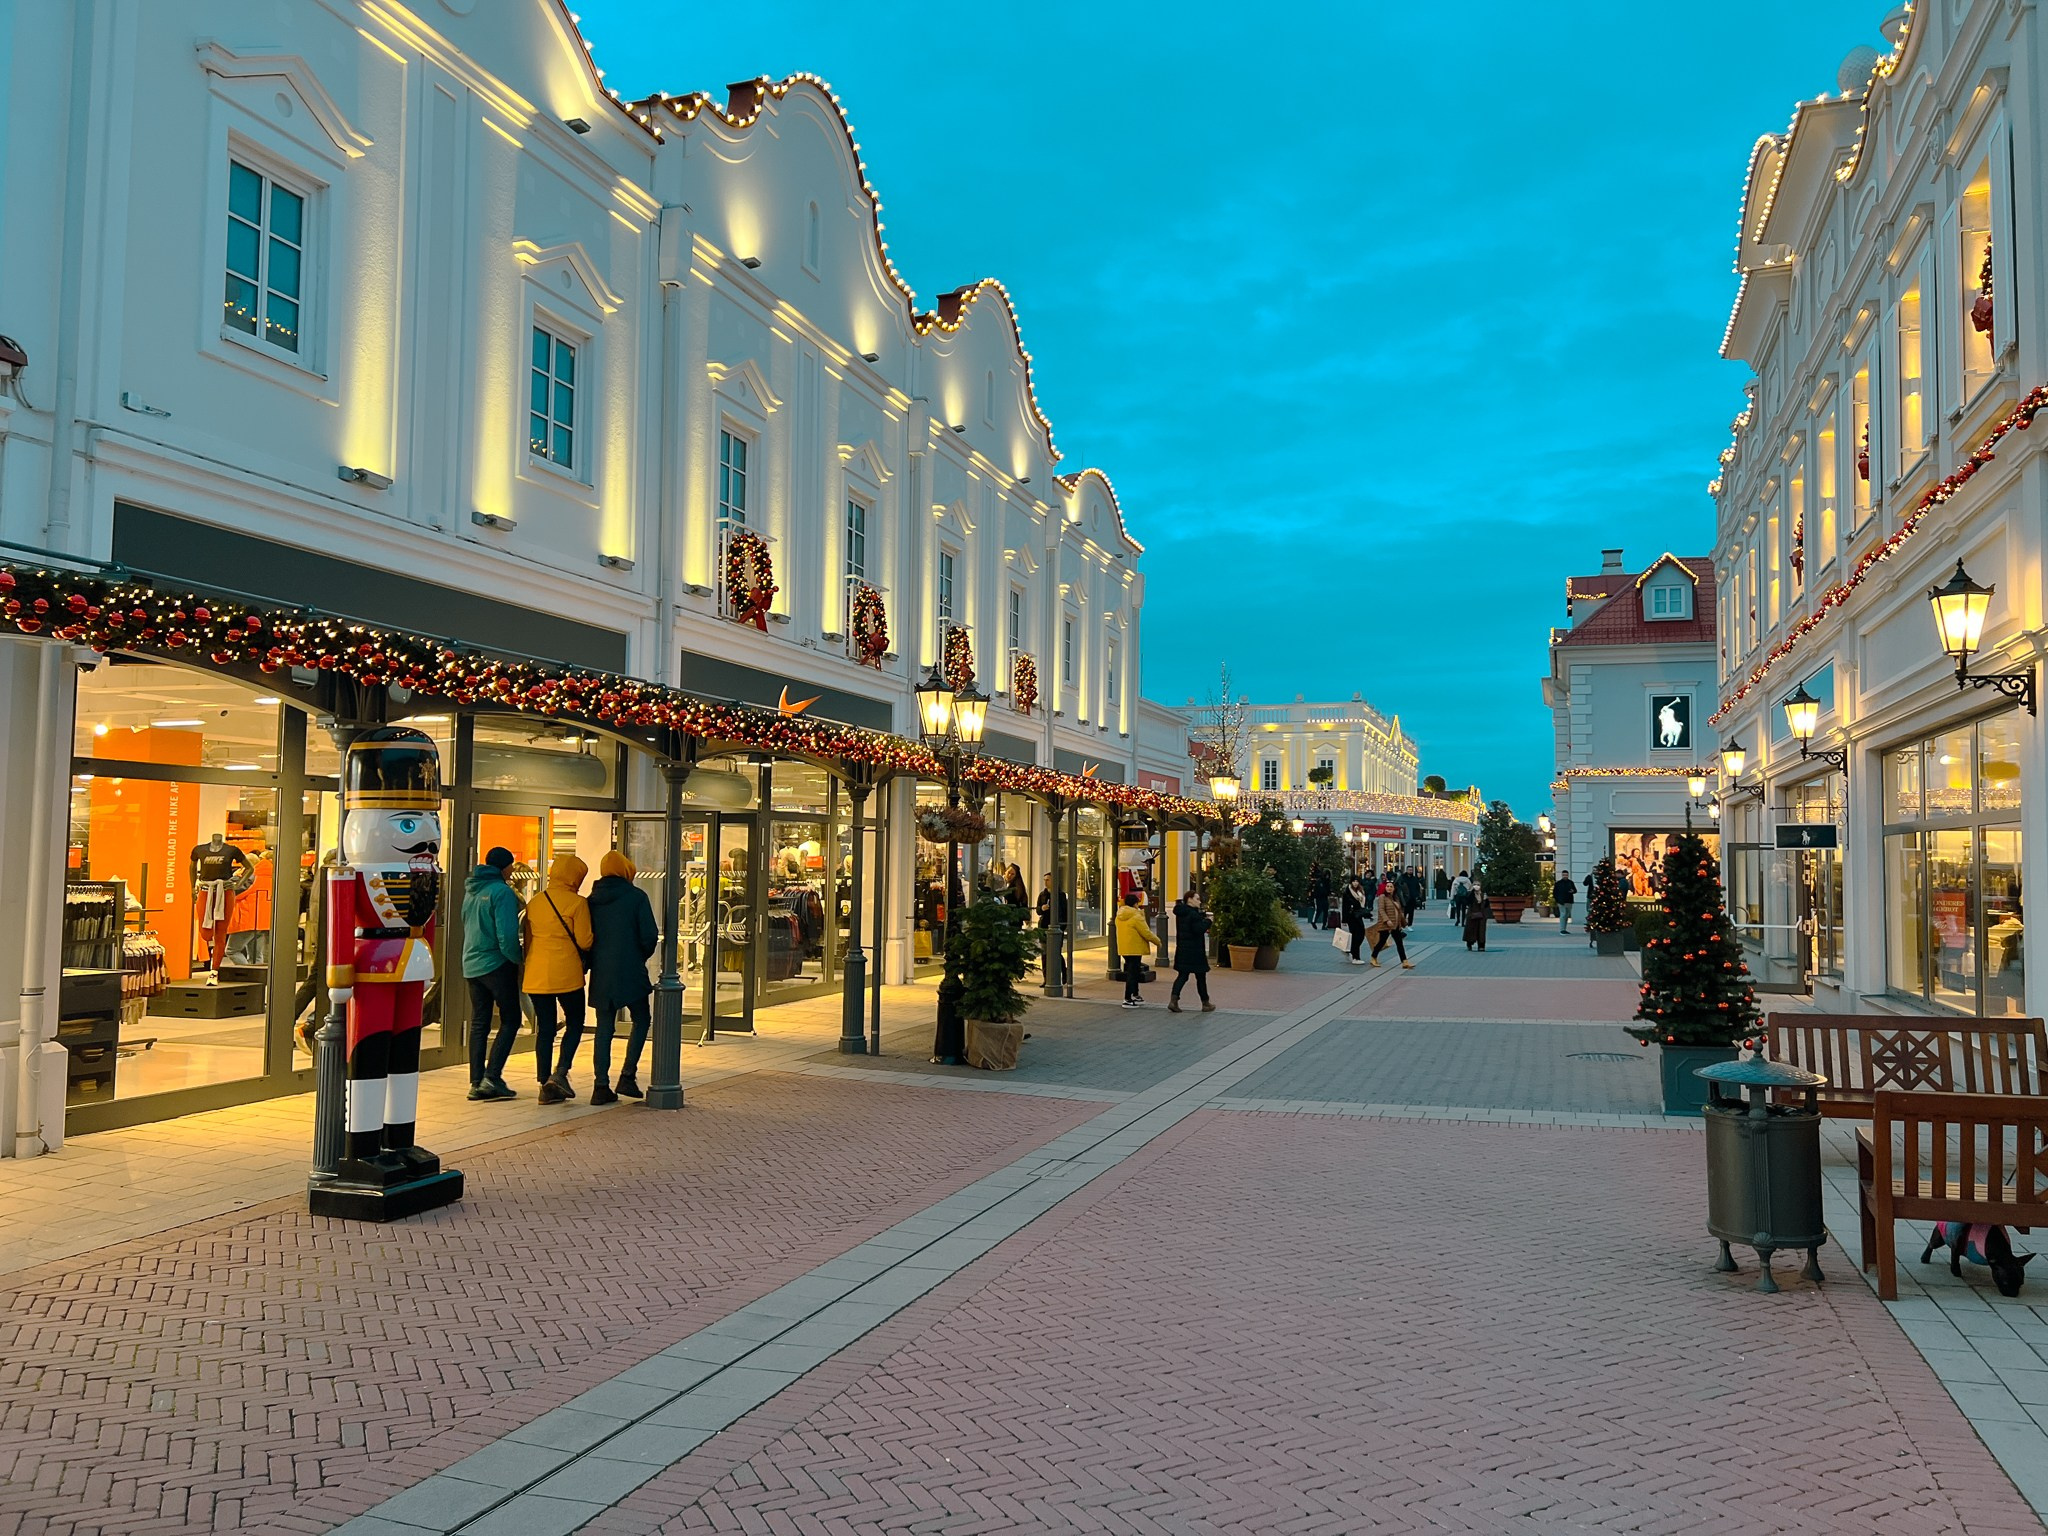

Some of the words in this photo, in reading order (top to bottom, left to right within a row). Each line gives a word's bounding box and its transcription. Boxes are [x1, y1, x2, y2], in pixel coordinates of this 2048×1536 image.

[169, 796, 179, 817] NIKE
[168, 819, 178, 836] THE
[165, 838, 177, 889] DOWNLOAD
[203, 855, 225, 865] NIKE
